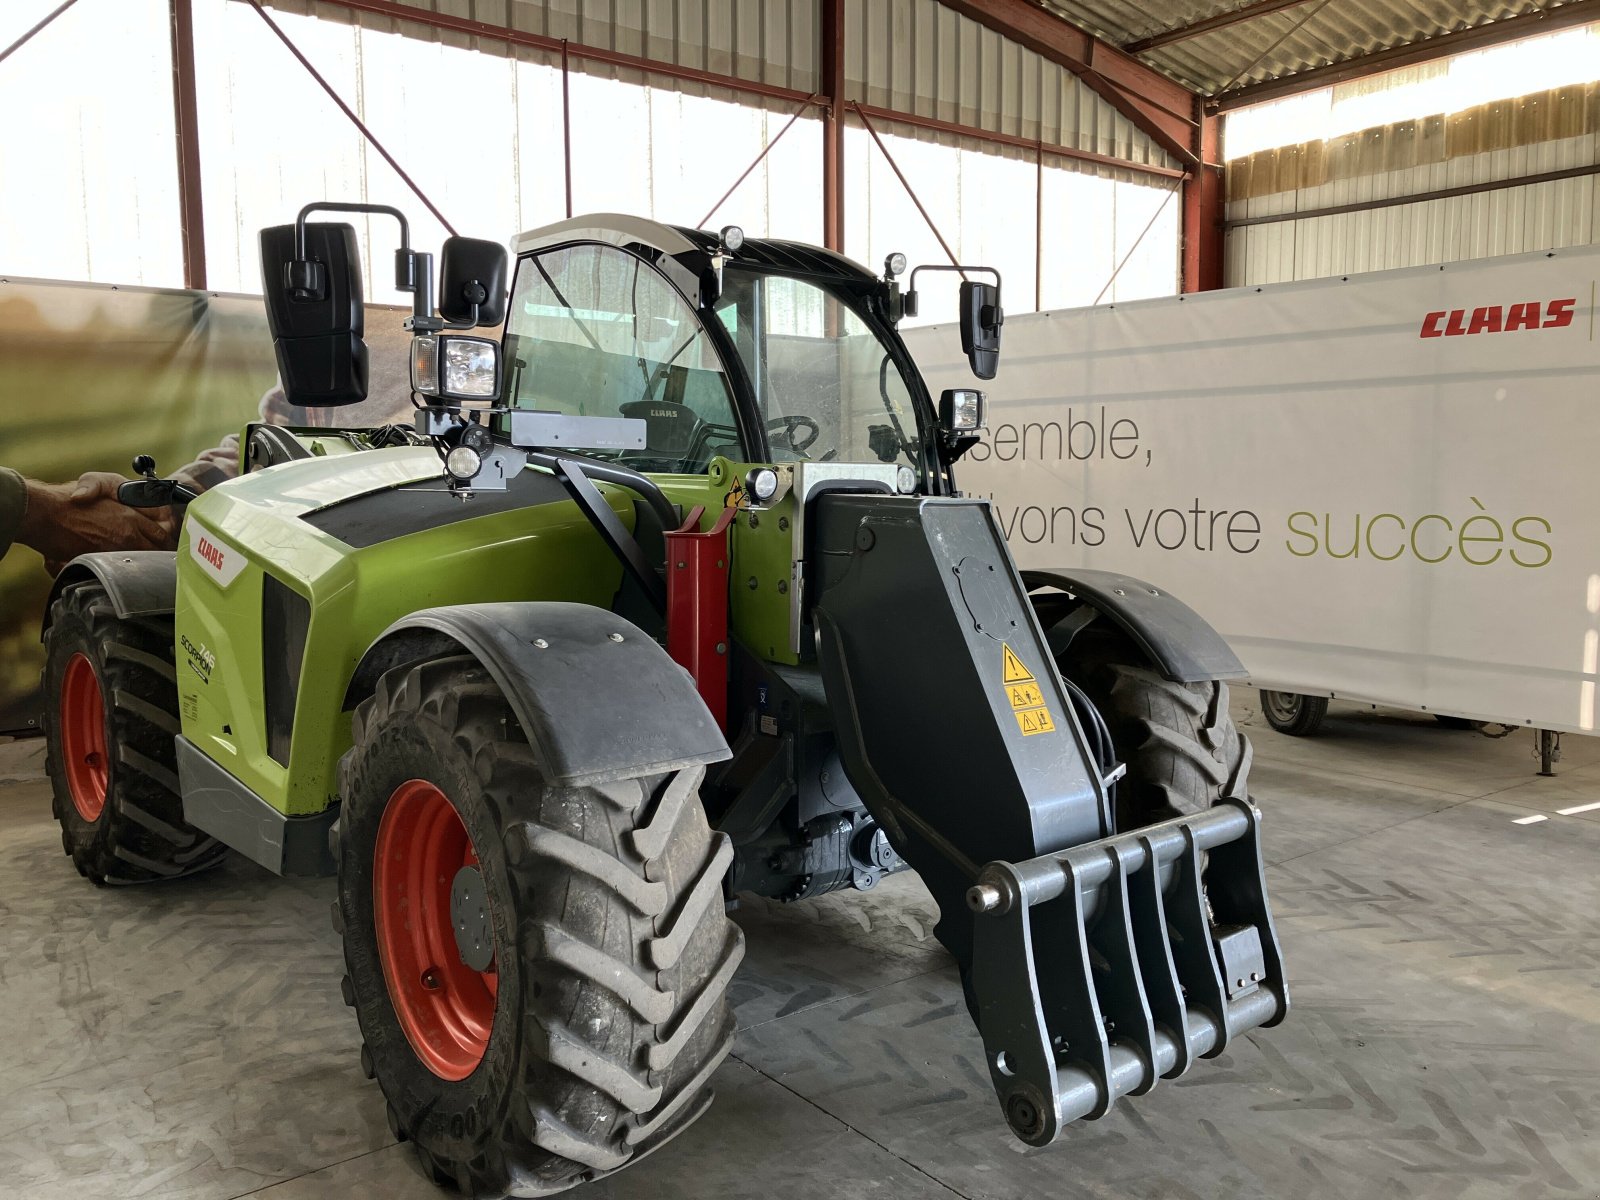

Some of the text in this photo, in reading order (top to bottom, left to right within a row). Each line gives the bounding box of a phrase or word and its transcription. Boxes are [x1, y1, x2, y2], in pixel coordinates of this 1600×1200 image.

[1420, 298, 1576, 338] CLAAS
[650, 409, 678, 418] CLAAS
[963, 405, 1152, 468] semble,
[968, 492, 1553, 568] vons votre succès
[197, 537, 225, 571] CLAAS
[180, 634, 212, 676] SCORPION
[199, 642, 216, 669] 746
